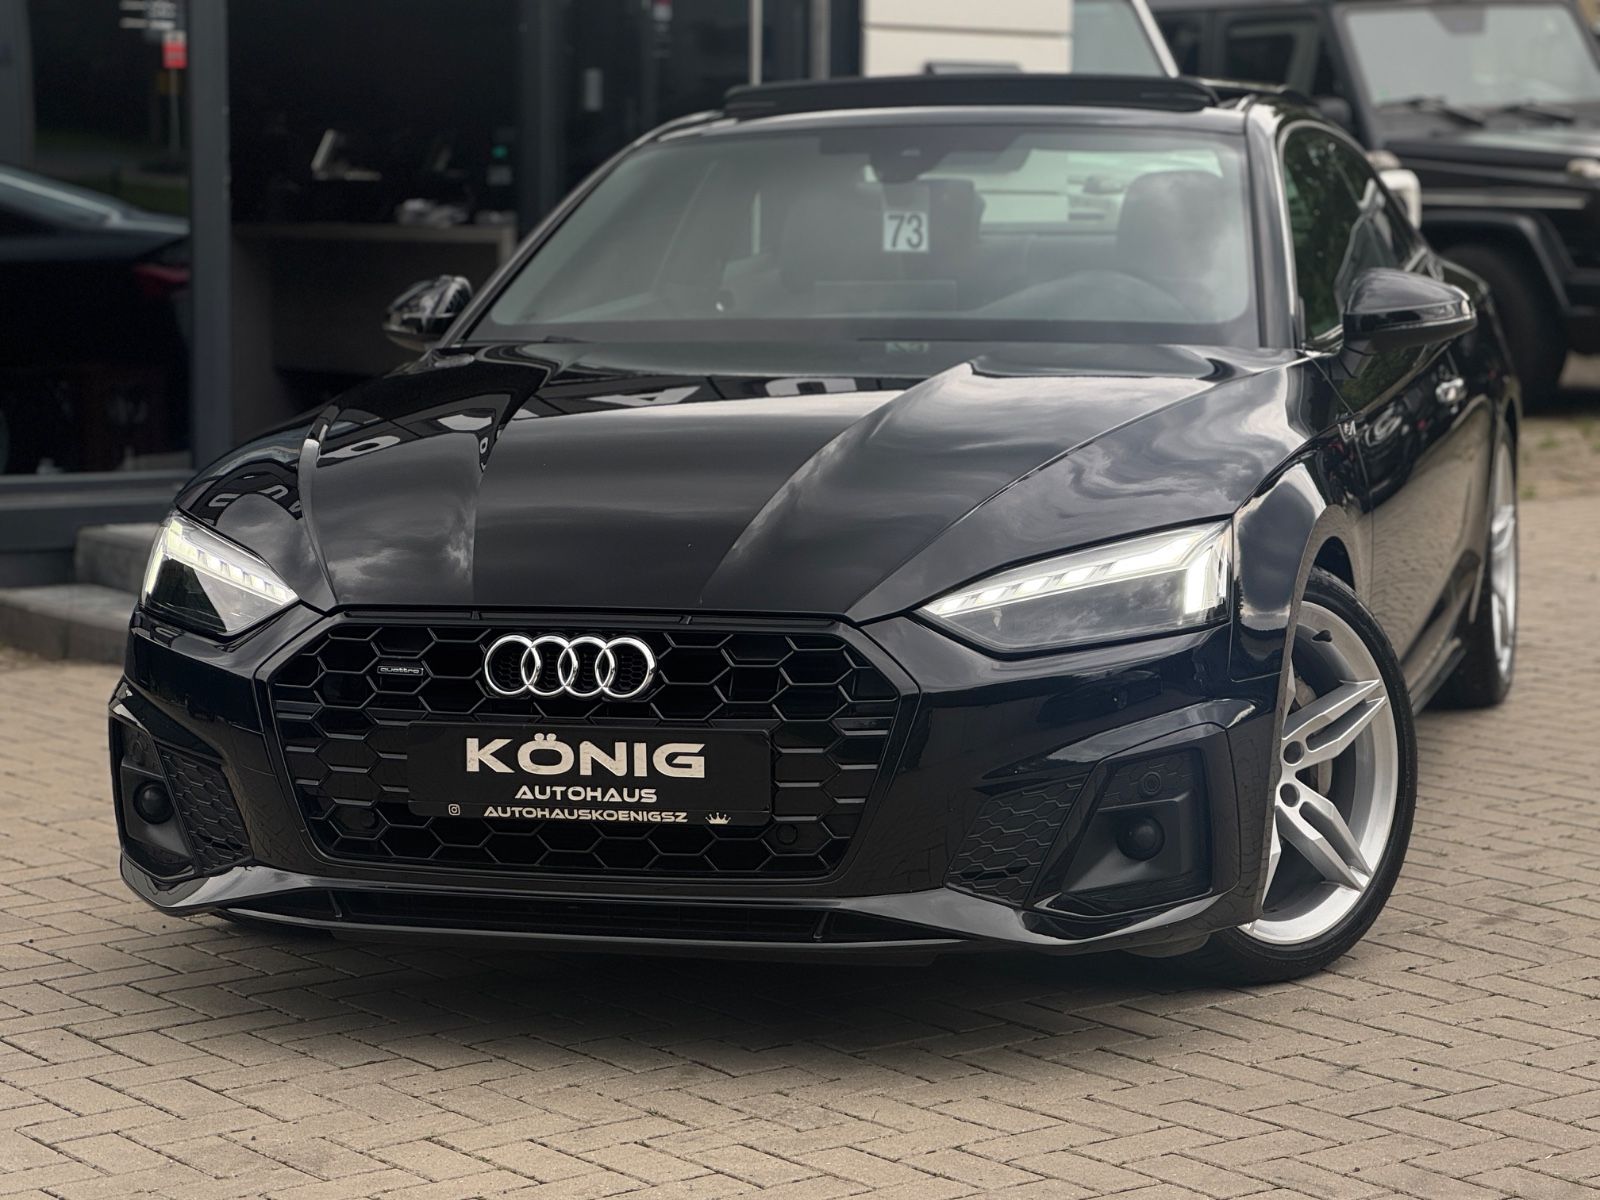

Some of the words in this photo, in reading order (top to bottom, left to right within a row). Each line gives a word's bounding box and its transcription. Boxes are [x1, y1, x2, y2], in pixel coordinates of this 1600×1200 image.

[888, 214, 924, 249] 73
[466, 733, 706, 778] KÖNIG
[514, 785, 658, 802] AUTOHAUS
[483, 806, 688, 823] AUTOHAUSKOENIGSZ
